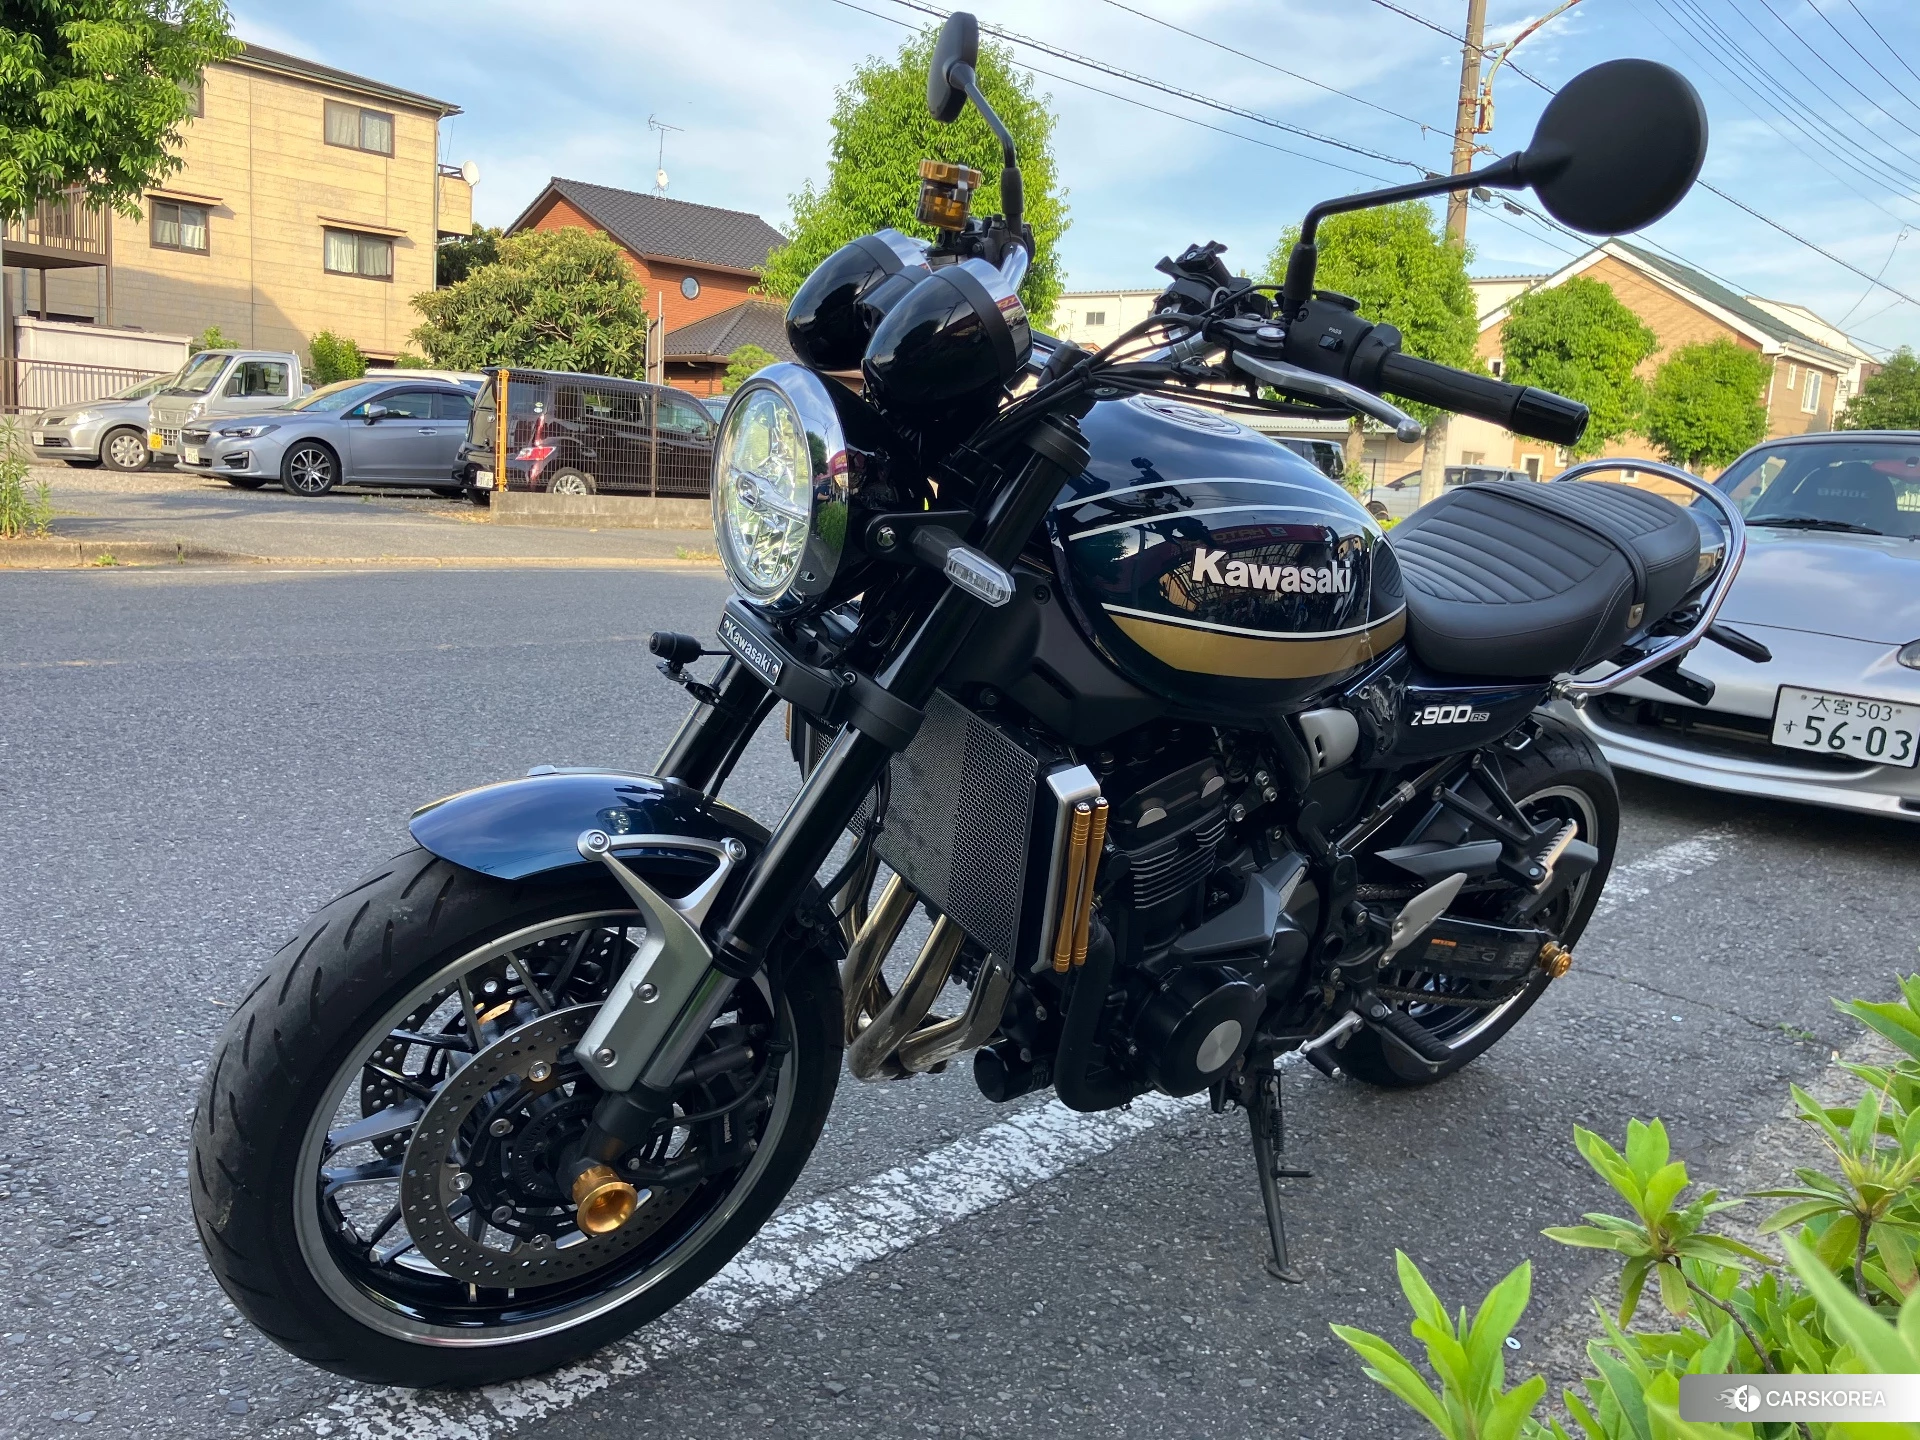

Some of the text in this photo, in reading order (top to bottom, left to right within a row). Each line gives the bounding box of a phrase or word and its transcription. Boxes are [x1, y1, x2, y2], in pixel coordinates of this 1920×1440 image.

[1191, 547, 1351, 594] Kawasaki
[726, 622, 772, 673] Kawasaki
[1783, 715, 1913, 761] す 56-03
